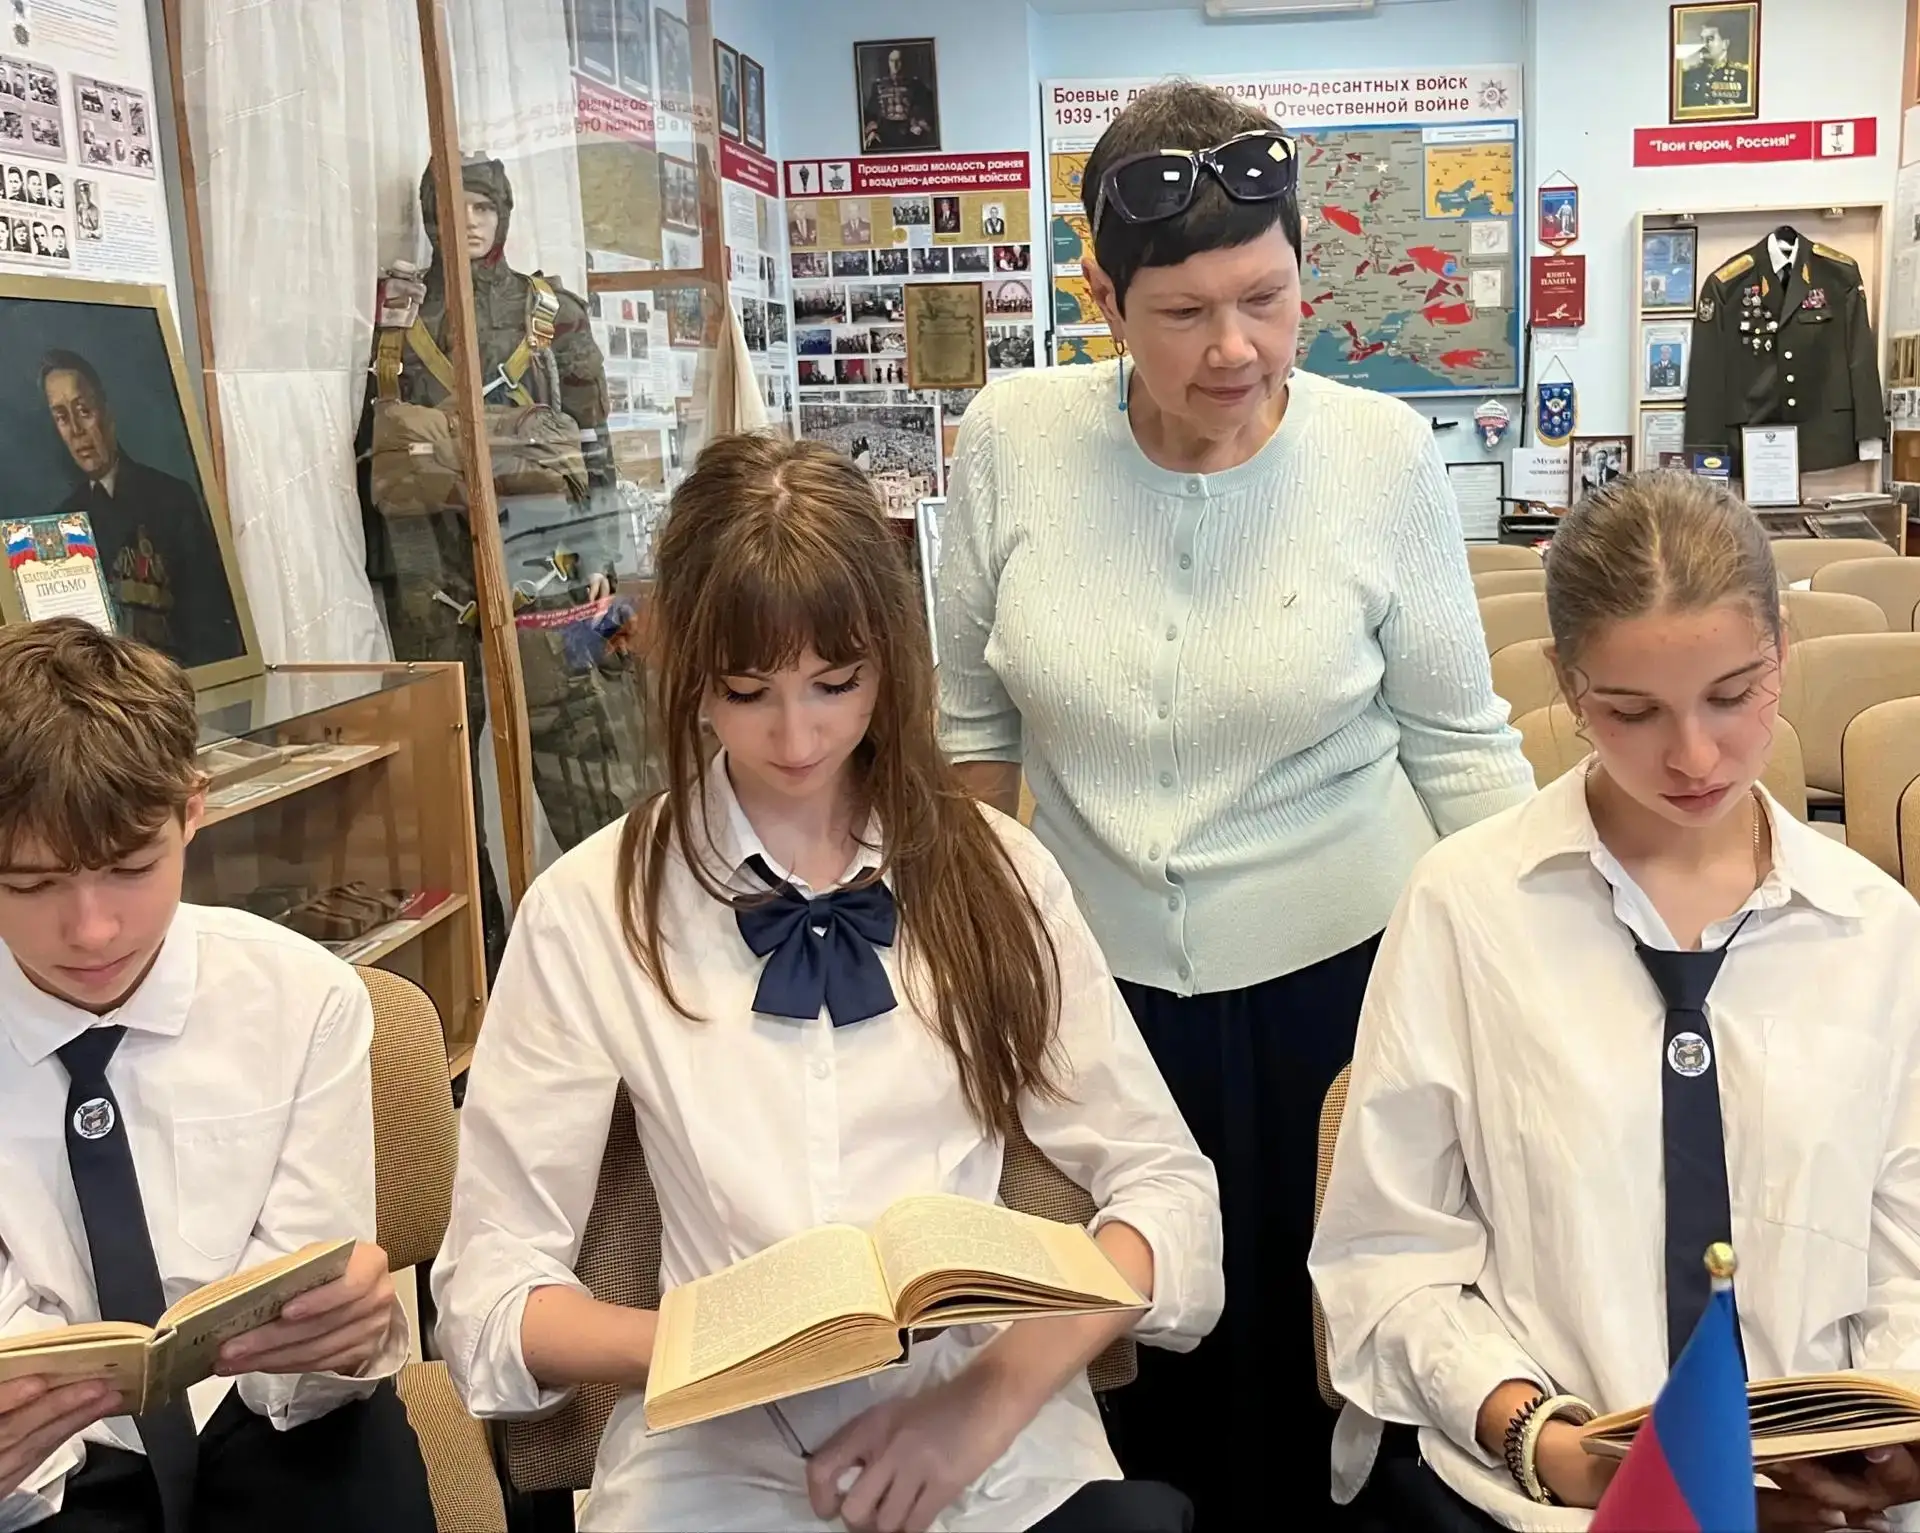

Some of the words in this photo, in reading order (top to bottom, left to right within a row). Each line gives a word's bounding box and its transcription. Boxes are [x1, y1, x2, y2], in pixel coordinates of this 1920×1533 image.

[1053, 87, 1119, 103] Боевые
[1416, 75, 1468, 90] войск
[1274, 98, 1408, 117] Отечественной
[1415, 97, 1469, 112] войне
[1688, 139, 1733, 152] герои,
[858, 163, 899, 175] Прошла
[901, 162, 929, 173] наша
[931, 161, 986, 172] молодость
[987, 159, 1024, 171] ранняя
[861, 178, 867, 187] в
[869, 175, 977, 188] воздушно-десантных
[979, 172, 1022, 183] войсках
[1540, 277, 1577, 285] ПАМЯТИ
[36, 577, 87, 597] ПИСЬМО
